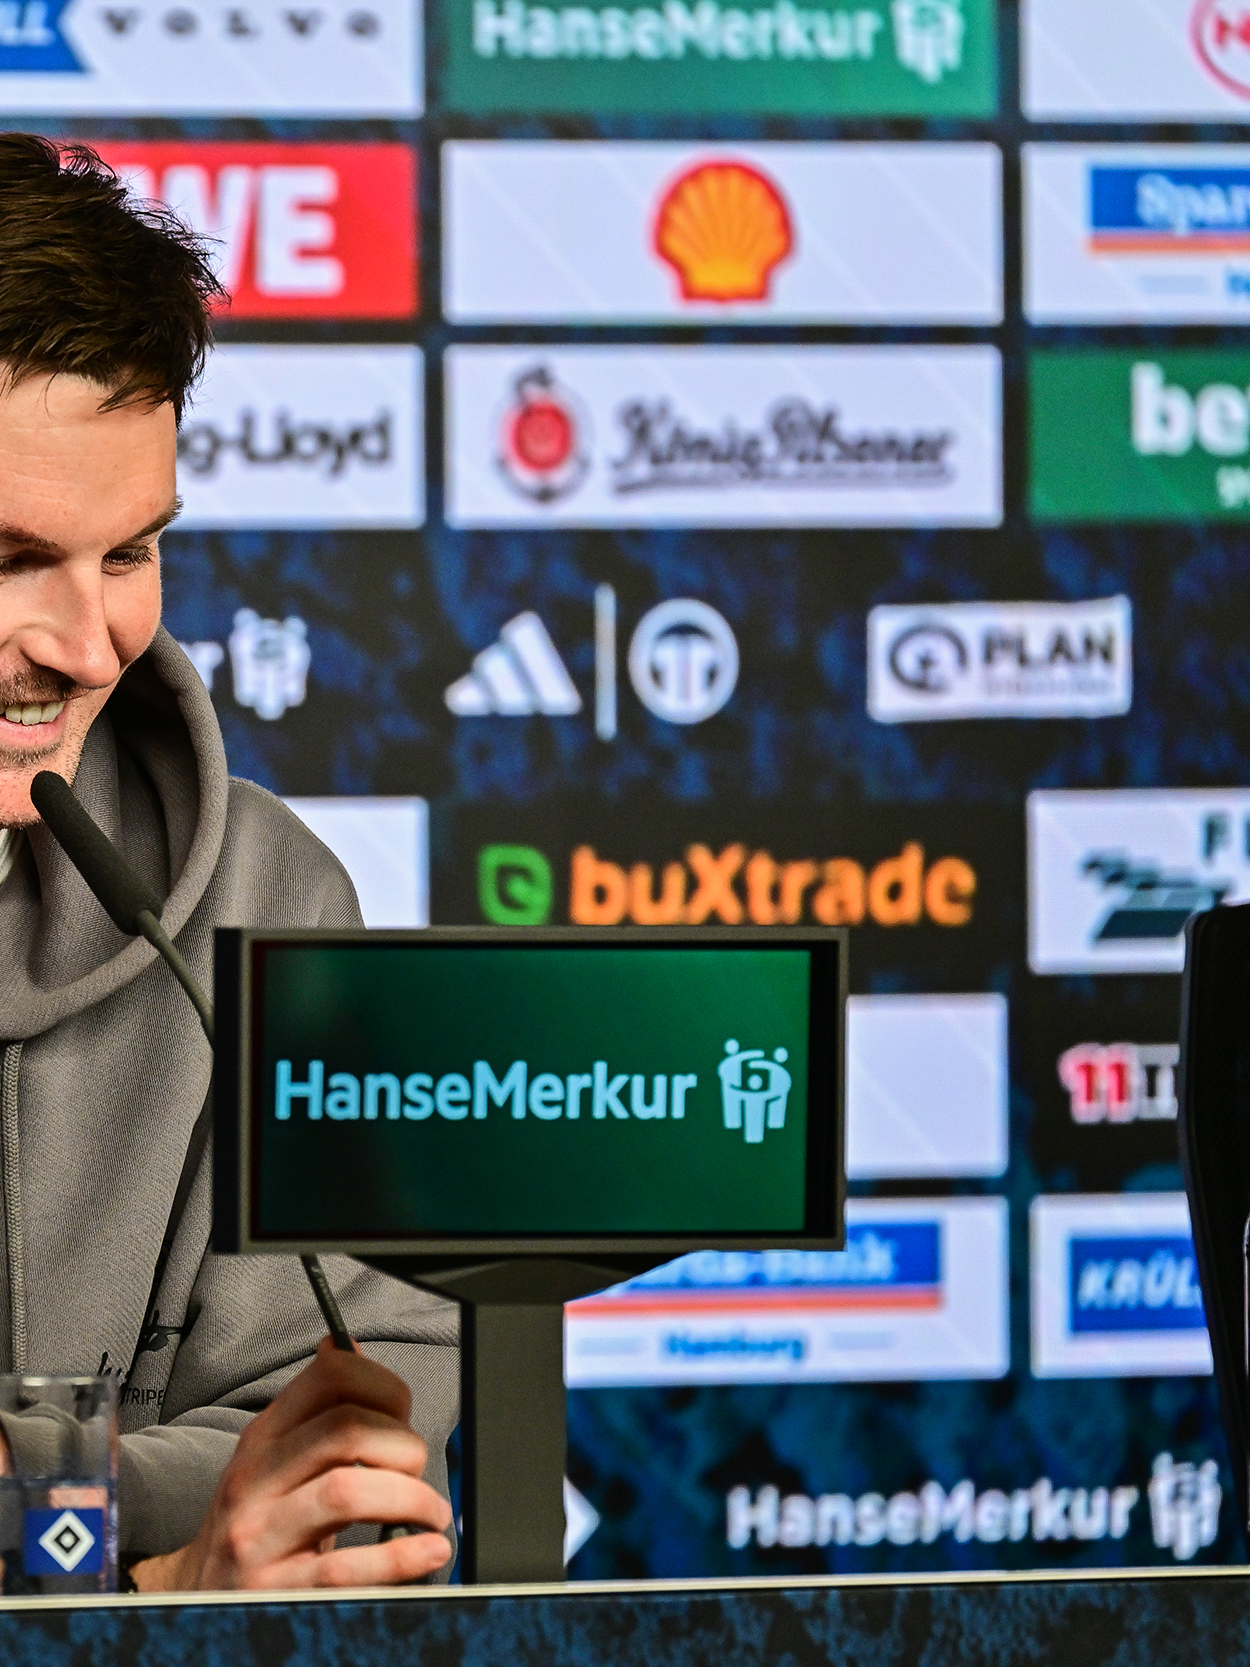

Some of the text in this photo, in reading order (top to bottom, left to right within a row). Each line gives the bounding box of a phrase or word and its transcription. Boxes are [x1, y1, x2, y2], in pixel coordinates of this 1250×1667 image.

[102, 8, 381, 42] VOLVO
[472, 0, 883, 60] HanseMerkur
[112, 163, 348, 299] WE
[177, 408, 392, 481] g-Lloyd
[982, 625, 1116, 668] PLAN
[568, 841, 976, 927] buXtrade
[274, 1059, 698, 1121] HanseMerkur
[1077, 1249, 1203, 1312] KRÜL
[726, 1476, 1140, 1550] HanseMerkur
